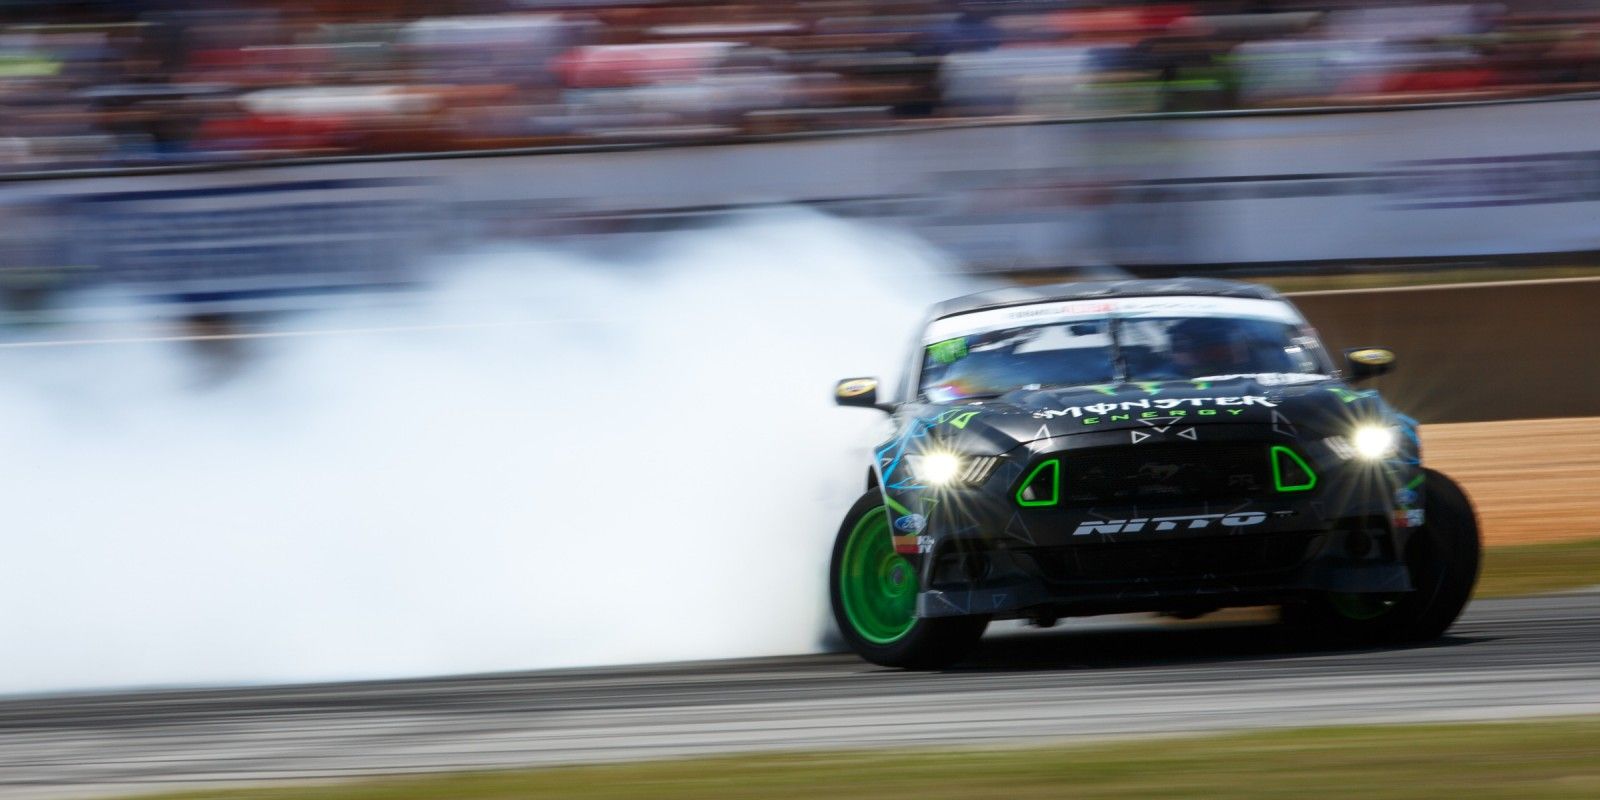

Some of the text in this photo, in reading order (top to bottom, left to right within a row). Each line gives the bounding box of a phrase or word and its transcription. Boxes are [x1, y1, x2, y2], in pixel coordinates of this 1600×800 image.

[1034, 395, 1279, 419] MONSTER
[1082, 409, 1244, 425] ENERGY
[1072, 511, 1267, 536] NITTO
